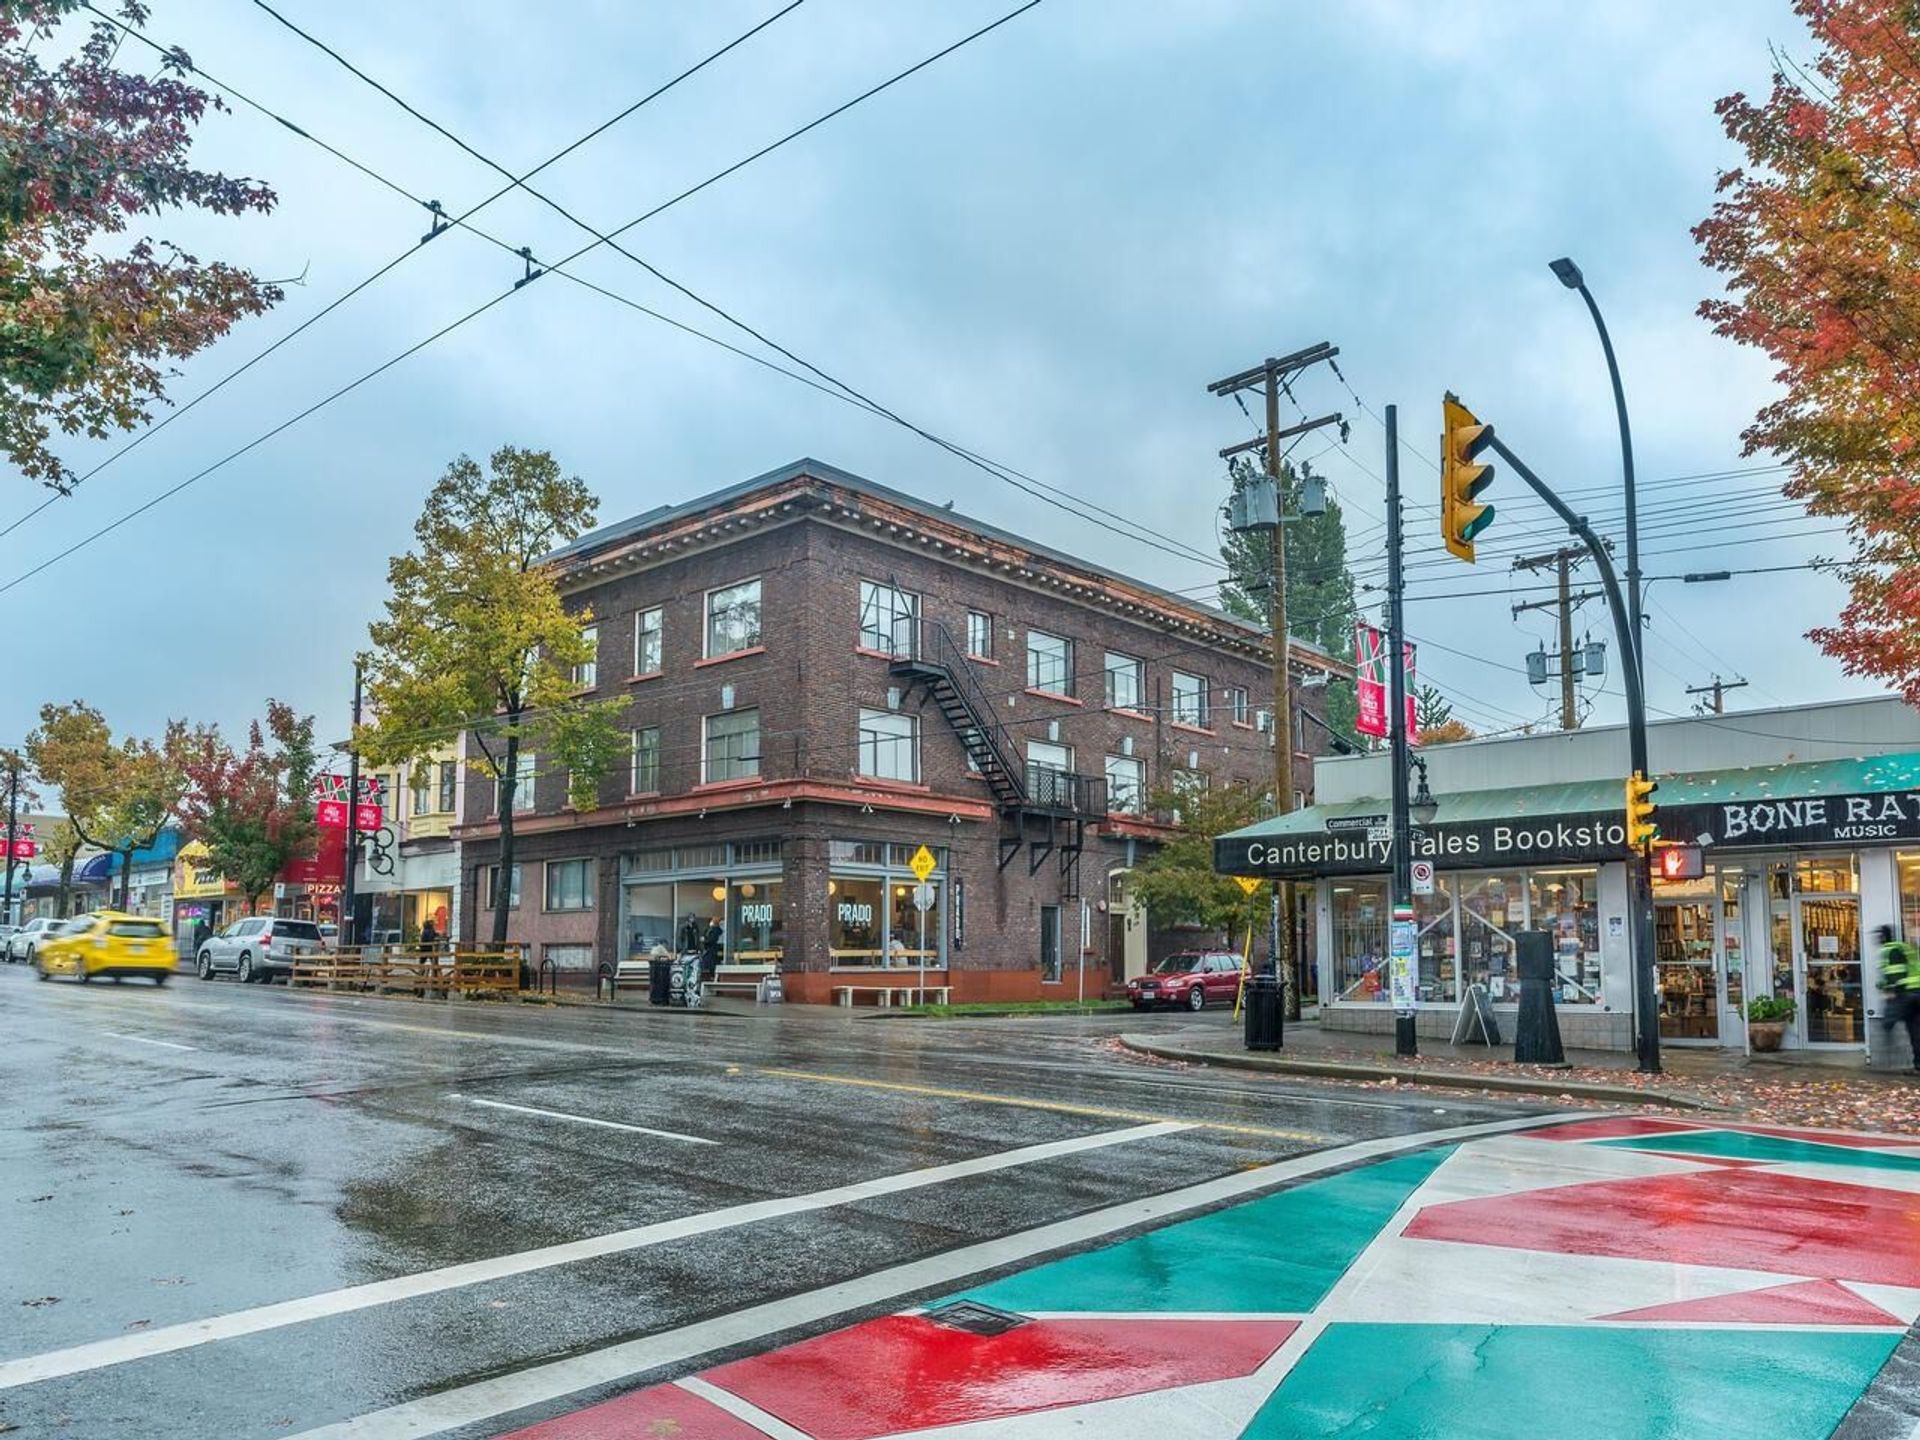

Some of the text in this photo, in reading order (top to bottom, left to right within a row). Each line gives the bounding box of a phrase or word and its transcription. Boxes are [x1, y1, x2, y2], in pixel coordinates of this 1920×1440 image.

[1328, 817, 1373, 828] Commercial
[1723, 800, 1827, 839] BONE
[1834, 824, 1897, 839] MUSIC
[1248, 838, 1393, 865] Canterbury
[1494, 822, 1624, 851] Booksto
[307, 884, 341, 894] PIZZA
[741, 904, 773, 923] PRADO
[838, 903, 872, 922] PRADO
